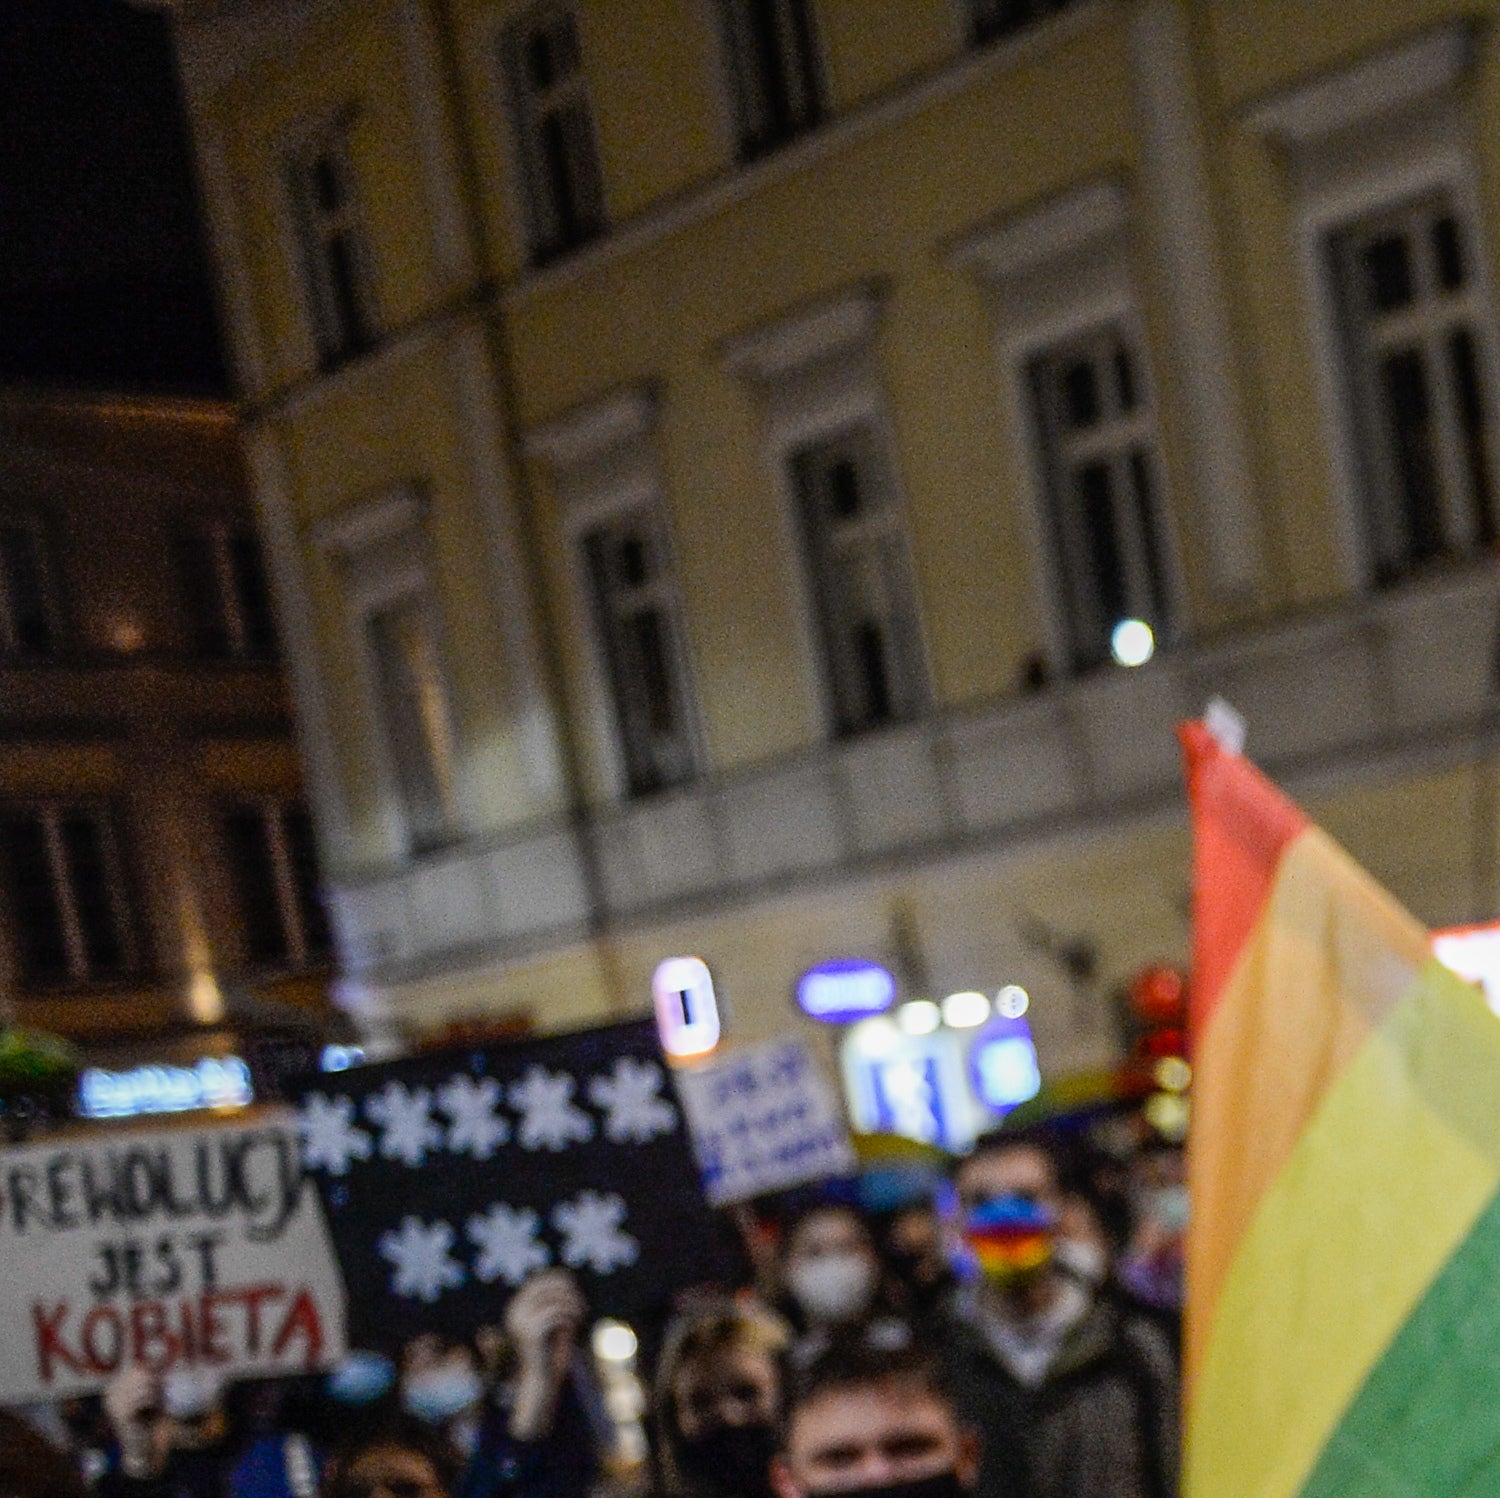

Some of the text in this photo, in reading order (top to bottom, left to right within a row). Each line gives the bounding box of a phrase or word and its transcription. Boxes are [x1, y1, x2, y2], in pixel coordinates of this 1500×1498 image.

[8, 1128, 304, 1240] REWOLUCJ
[90, 1228, 225, 1297] JEST
[31, 1278, 325, 1388] KOBIETA
